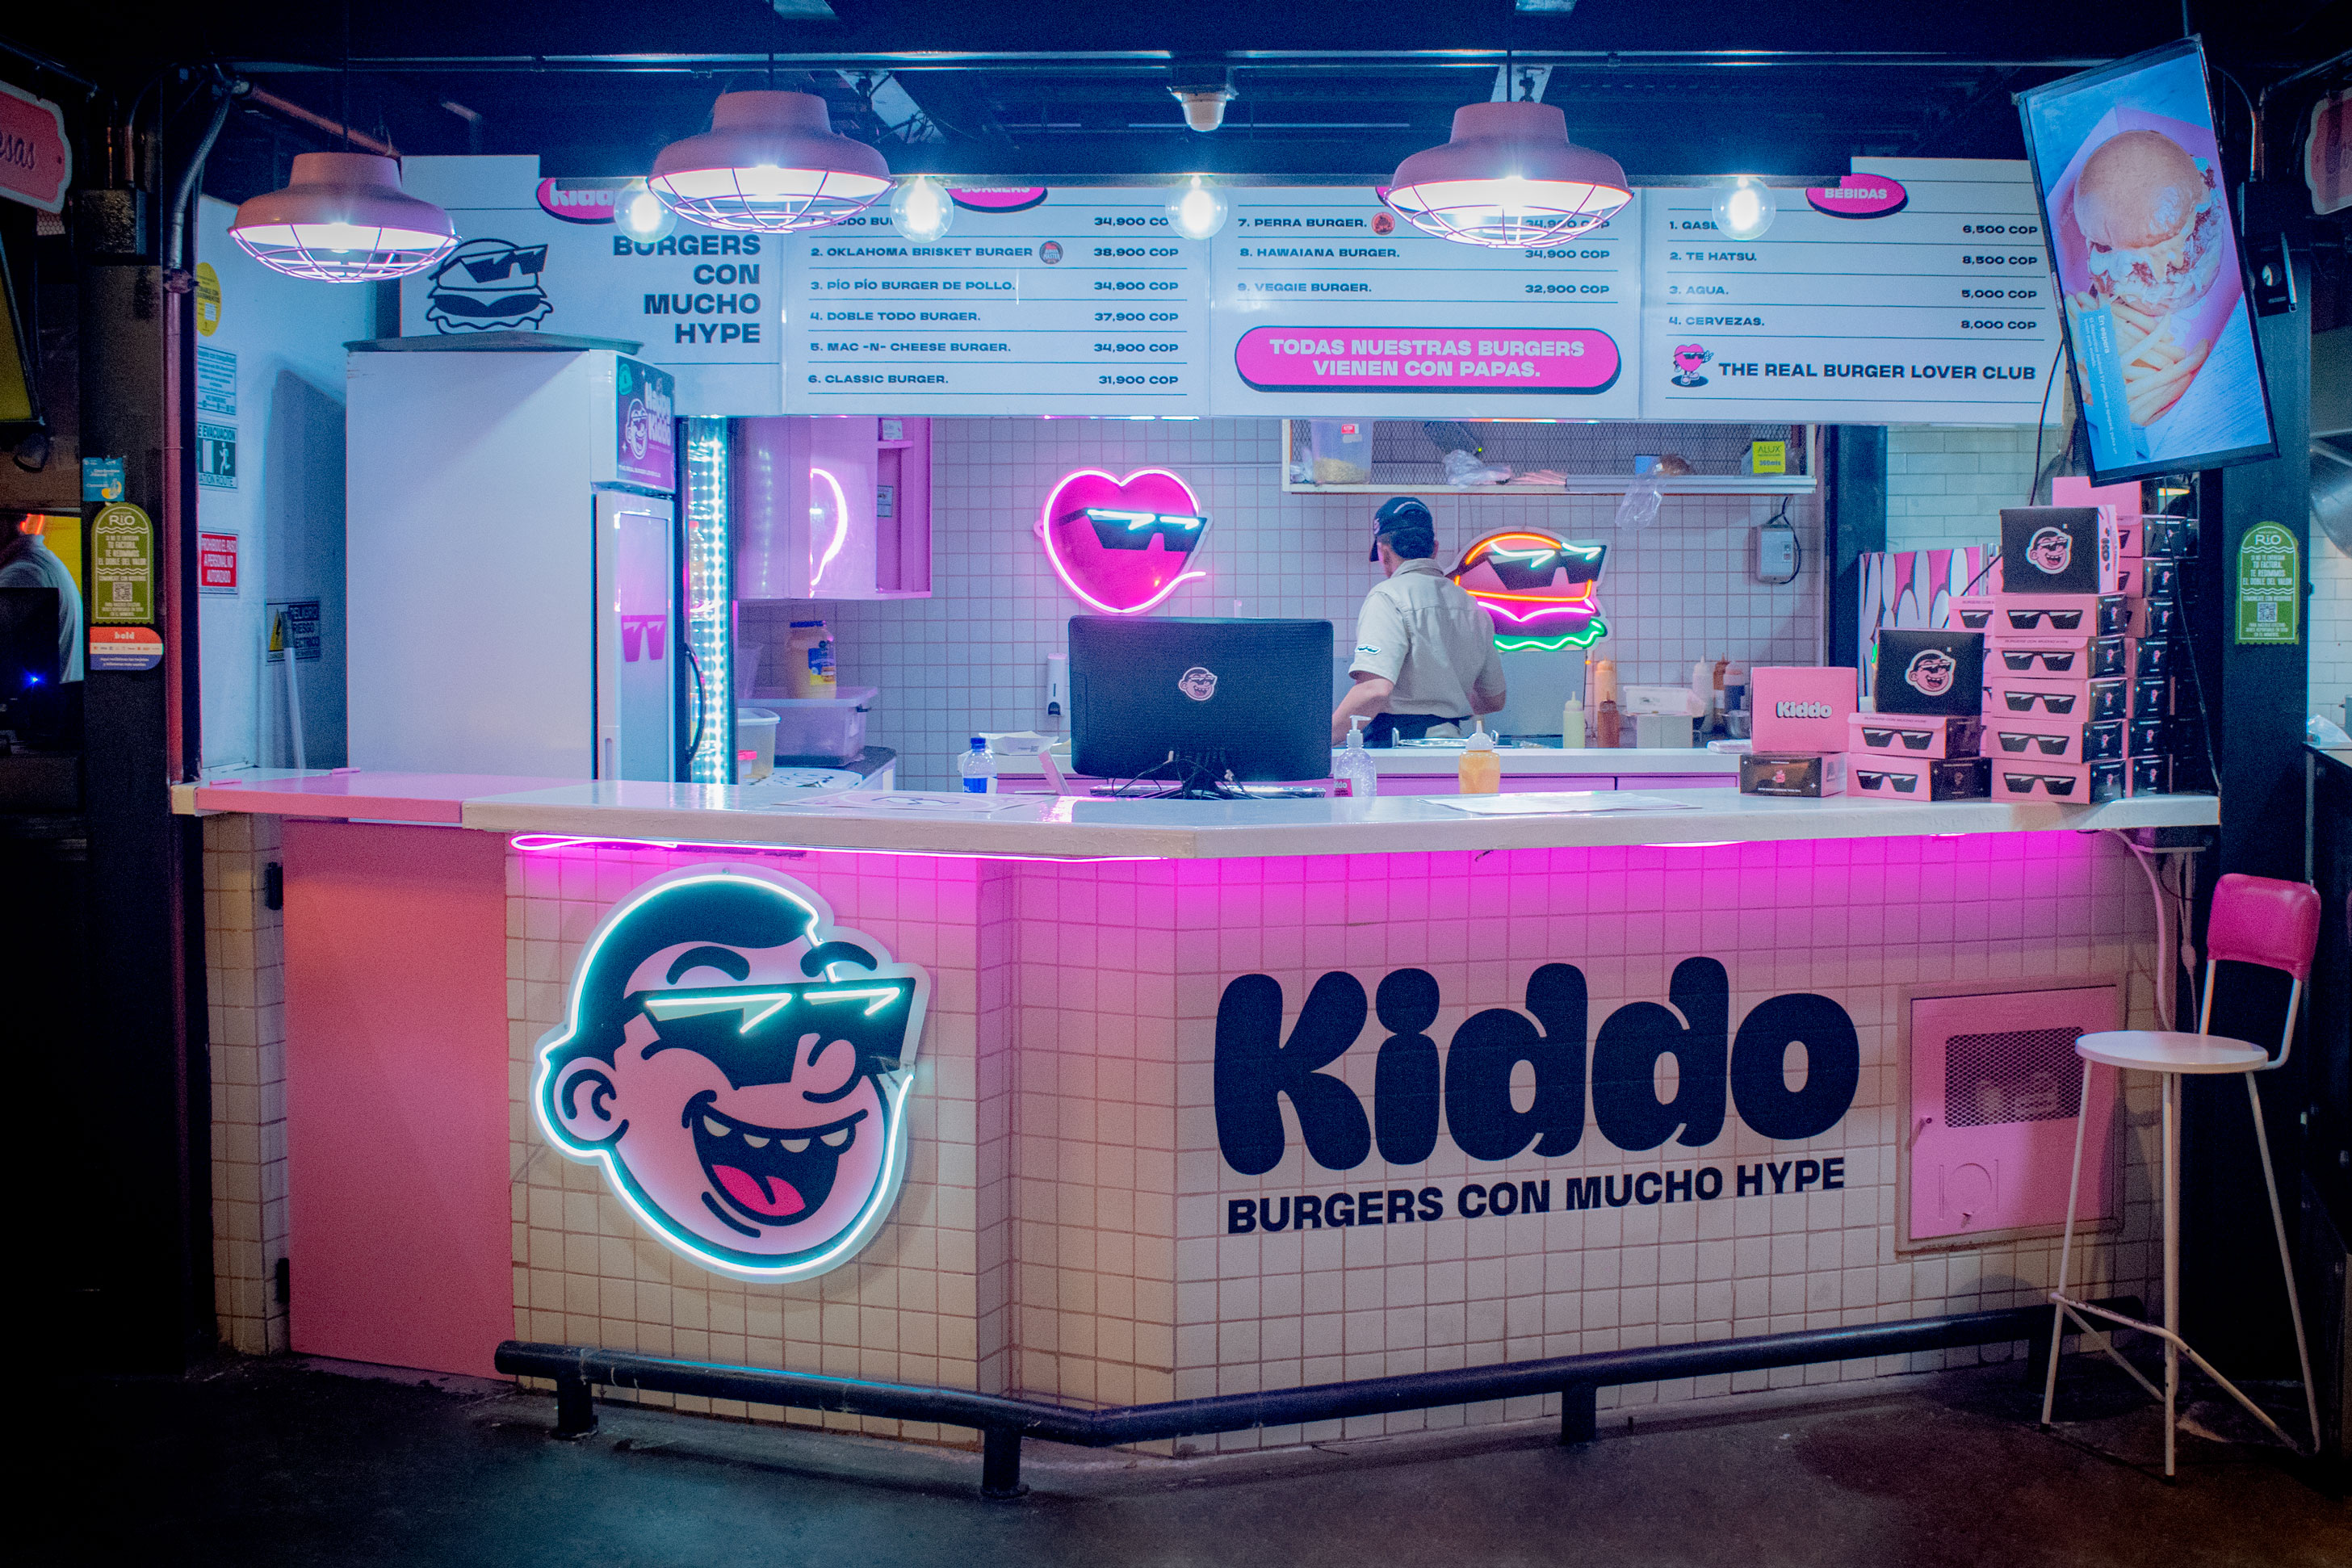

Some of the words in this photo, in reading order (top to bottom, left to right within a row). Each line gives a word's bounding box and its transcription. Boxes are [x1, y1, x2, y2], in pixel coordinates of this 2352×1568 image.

[1825, 188, 1888, 199] BEBIDAS
[1095, 217, 1146, 226] 34,900
[1150, 217, 1168, 226] CO
[1239, 219, 1251, 227] 7.
[1255, 219, 1302, 227] PERRA
[1306, 219, 1367, 228] BURGER.
[1670, 221, 1678, 229] 1.
[1963, 225, 2005, 234] 6,500
[2009, 226, 2038, 234] COP
[614, 234, 761, 256] BURGERS
[811, 248, 823, 257] 2.
[827, 248, 908, 257] OKLAHOMA
[912, 248, 971, 257] BRISKET
[976, 248, 1032, 257] BURGER
[1095, 248, 1146, 258] 38,900
[1150, 248, 1178, 257] COP
[1240, 249, 1252, 257] 8.
[1257, 249, 1334, 257] HAWAIANA
[1340, 249, 1400, 258] BURGER.
[1525, 249, 1577, 258] 34,900
[1580, 249, 1610, 258] COP
[1670, 252, 1681, 260] 2.
[1687, 252, 1703, 261] TE
[1708, 252, 1757, 261] HATSU.
[1963, 256, 2005, 265] 8,500
[2009, 257, 2038, 265] COP
[694, 264, 760, 285] CON
[811, 282, 822, 290] 3.
[828, 279, 850, 290] PÍO
[854, 279, 878, 290] PÍO
[882, 282, 938, 290] BURGER
[943, 282, 961, 290] DE
[966, 282, 1015, 290] POLLO.
[1095, 282, 1146, 291] 34,900
[1149, 282, 1178, 290] COP
[1239, 283, 1250, 291] 9.
[1255, 283, 1306, 291] VEGGIE
[1311, 283, 1372, 292] BURGER.
[1525, 285, 1577, 294] 32,900
[1580, 285, 1610, 294] COP
[1670, 286, 1682, 295] 3.
[1686, 286, 1729, 295] AGUA.
[1962, 290, 2005, 299] 5,000
[2008, 290, 2037, 299] COP
[644, 294, 761, 315] MUCHO
[811, 312, 823, 321] 4.
[828, 312, 873, 321] DOBLE
[878, 312, 916, 321] TODO
[920, 312, 980, 321] BURGER.
[1095, 312, 1146, 321] 37,900
[1150, 312, 1178, 321] COP
[1669, 317, 1682, 325] 4.
[1686, 317, 1765, 325] CERVEZAS.
[2098, 315, 2106, 325] En
[1961, 321, 2004, 330] 8,000
[2008, 321, 2037, 329] COP
[675, 323, 760, 344] HYPE
[2099, 327, 2111, 354] espera
[811, 343, 823, 351] 5.
[828, 343, 858, 351] MAC
[863, 343, 886, 351] -N-
[891, 343, 945, 351] CHEESE
[950, 343, 1011, 351] BURGER.
[1095, 343, 1146, 353] 34,900
[1149, 344, 1178, 352] COP
[1269, 339, 1345, 355] TODAS
[1352, 340, 1472, 356] NUESTRAS
[1478, 341, 1585, 357] BURGERS
[1313, 360, 1398, 376] VIENEN
[1405, 361, 1453, 377] CON
[1460, 362, 1541, 378] PAPAS.
[1719, 363, 1759, 376] THE
[1766, 363, 1817, 377] REAL
[1824, 364, 1905, 379] BURGER
[1912, 365, 1977, 379] LOVER
[1983, 366, 2035, 380] CLUB
[808, 375, 821, 384] 6.
[825, 375, 883, 384] CLASSIC
[888, 375, 949, 384] BURGER.
[1099, 375, 1146, 385] 31,900
[1149, 376, 1178, 384] COP
[1758, 445, 1781, 454] ALUX
[115, 631, 135, 639] bold
[1776, 701, 1832, 718] Kiddo
[1214, 955, 1860, 1176] Kiddo
[1227, 1185, 1444, 1235] BURGERS
[1457, 1179, 1551, 1219] CON
[1565, 1167, 1723, 1211] MUCHO
[1737, 1157, 1846, 1198] HYPE
